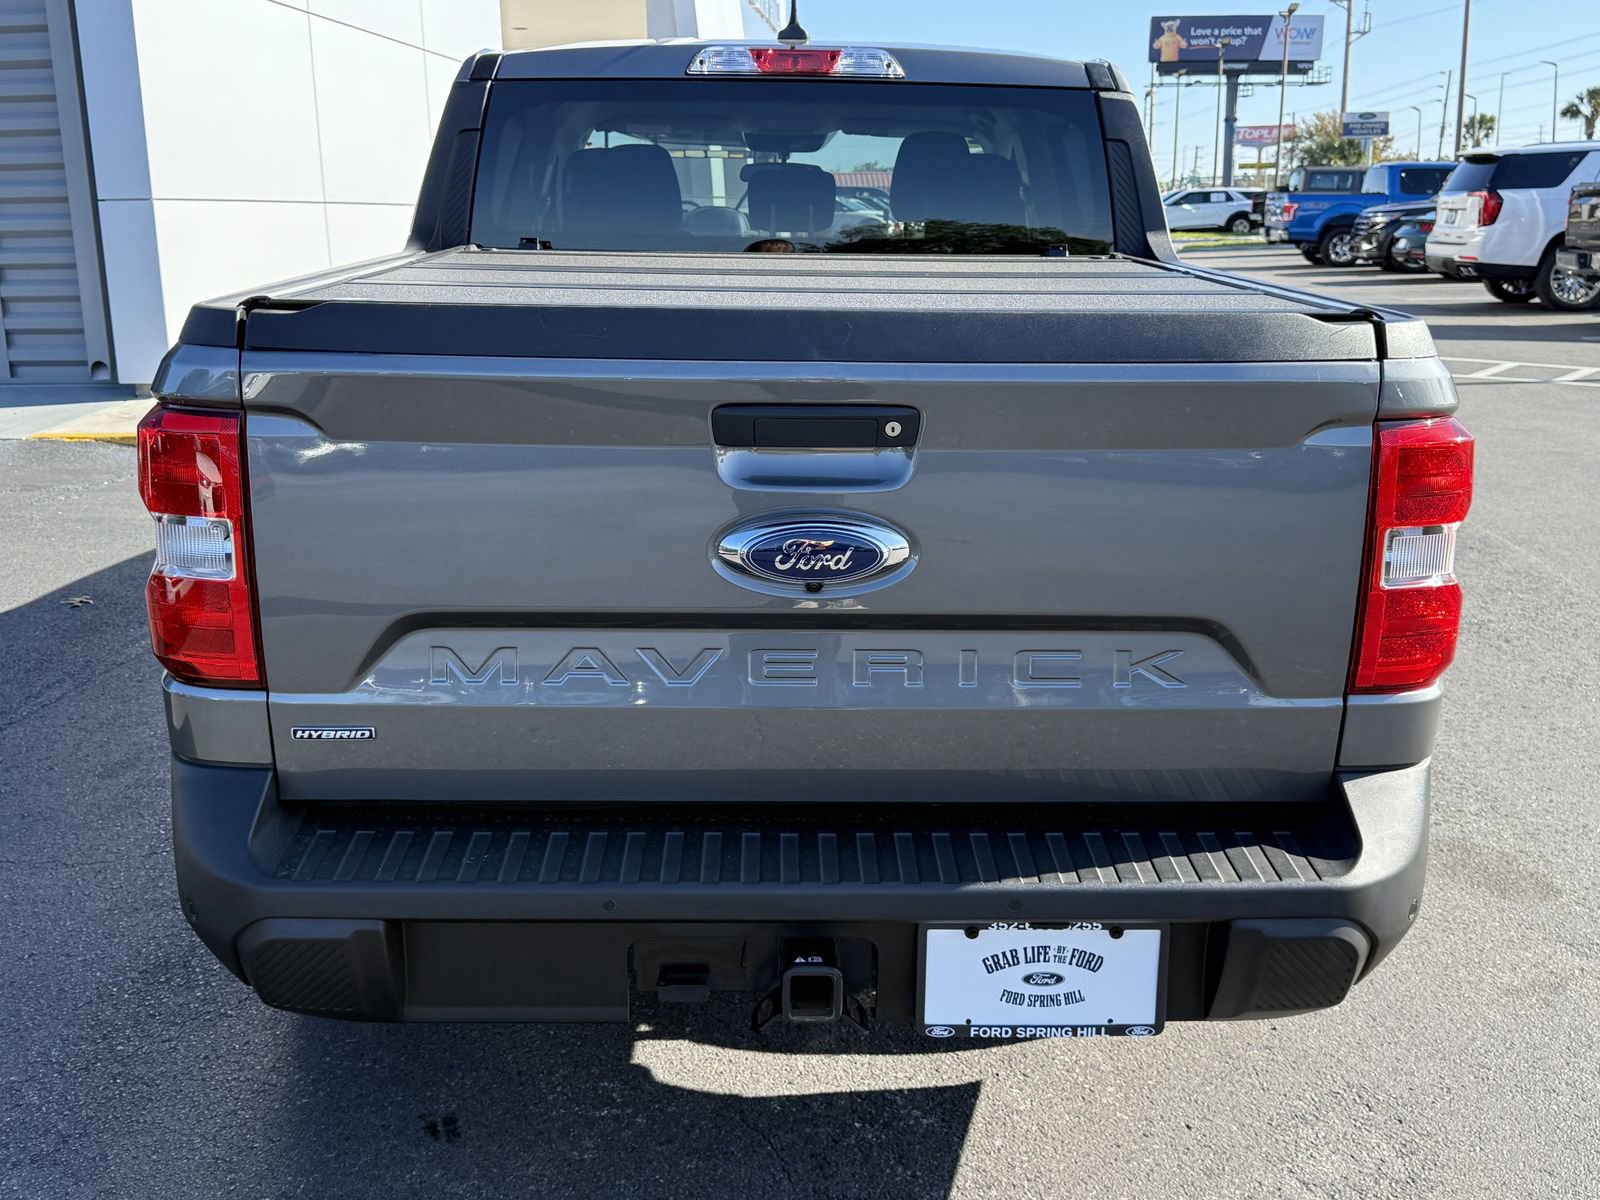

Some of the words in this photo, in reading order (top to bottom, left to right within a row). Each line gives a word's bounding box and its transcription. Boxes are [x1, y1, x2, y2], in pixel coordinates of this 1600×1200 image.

[1190, 27, 1212, 36] Love
[1220, 26, 1243, 37] price
[1244, 27, 1263, 36] that
[1190, 37, 1215, 46] won't
[1230, 36, 1248, 47] up?
[774, 538, 853, 571] Ford
[429, 645, 1187, 689] MAVERICK
[295, 730, 371, 739] HYBRID
[982, 948, 1020, 974] GRAB
[1023, 945, 1051, 964] LIFE
[1053, 955, 1068, 964] THE
[1068, 948, 1104, 973] FORD
[1029, 973, 1058, 984] Ford
[1000, 989, 1025, 1006] FORD
[1027, 993, 1062, 1007] SPRING
[1063, 989, 1086, 1005] HILL
[931, 1027, 950, 1036] Ford
[970, 1027, 1012, 1038] FORD
[1016, 1027, 1073, 1038] SPRING
[1077, 1027, 1110, 1037] HILL
[1131, 1026, 1150, 1035] Ford
